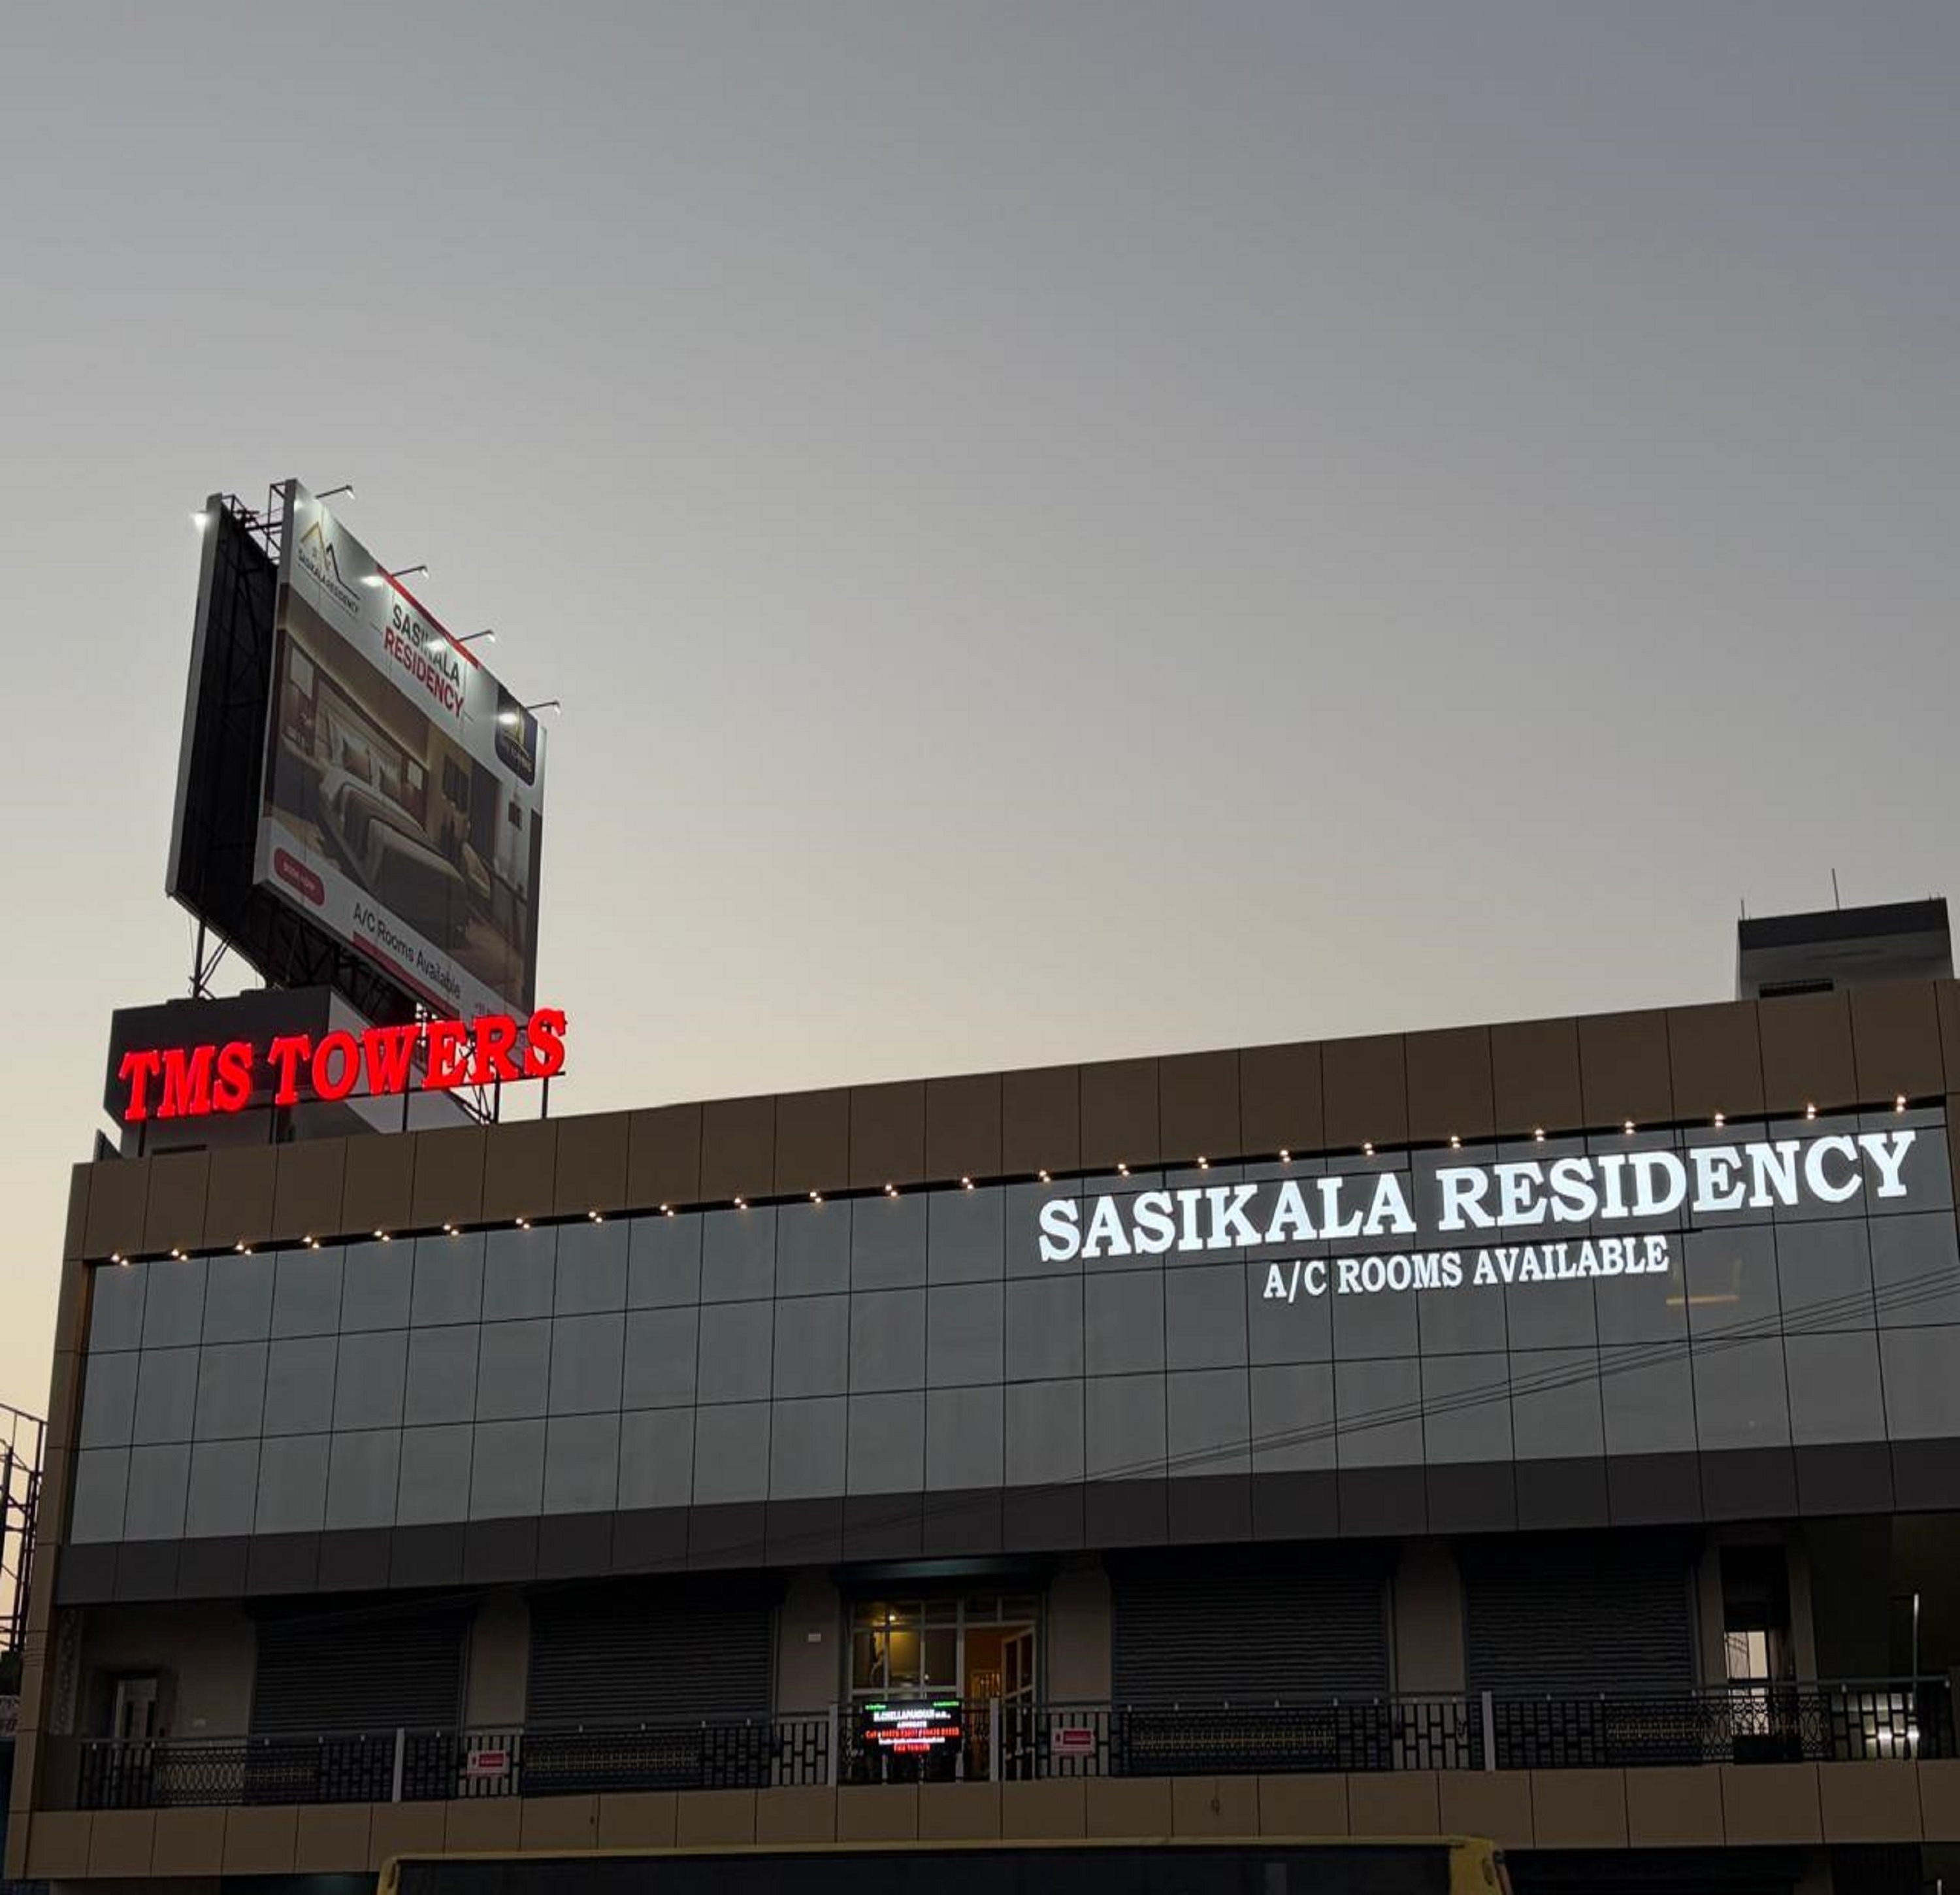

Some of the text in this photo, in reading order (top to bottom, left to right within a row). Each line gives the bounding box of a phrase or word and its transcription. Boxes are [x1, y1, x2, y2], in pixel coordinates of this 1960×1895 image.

[384, 626, 464, 717] RESIDENCY
[353, 902, 460, 999] A/C Rooms Available
[118, 1008, 566, 1121] TMS TOWERS
[1039, 1130, 1916, 1262] SASIKALA RESIDENCY
[1263, 1235, 1670, 1303] A/C ROOMS AVAILABLE
